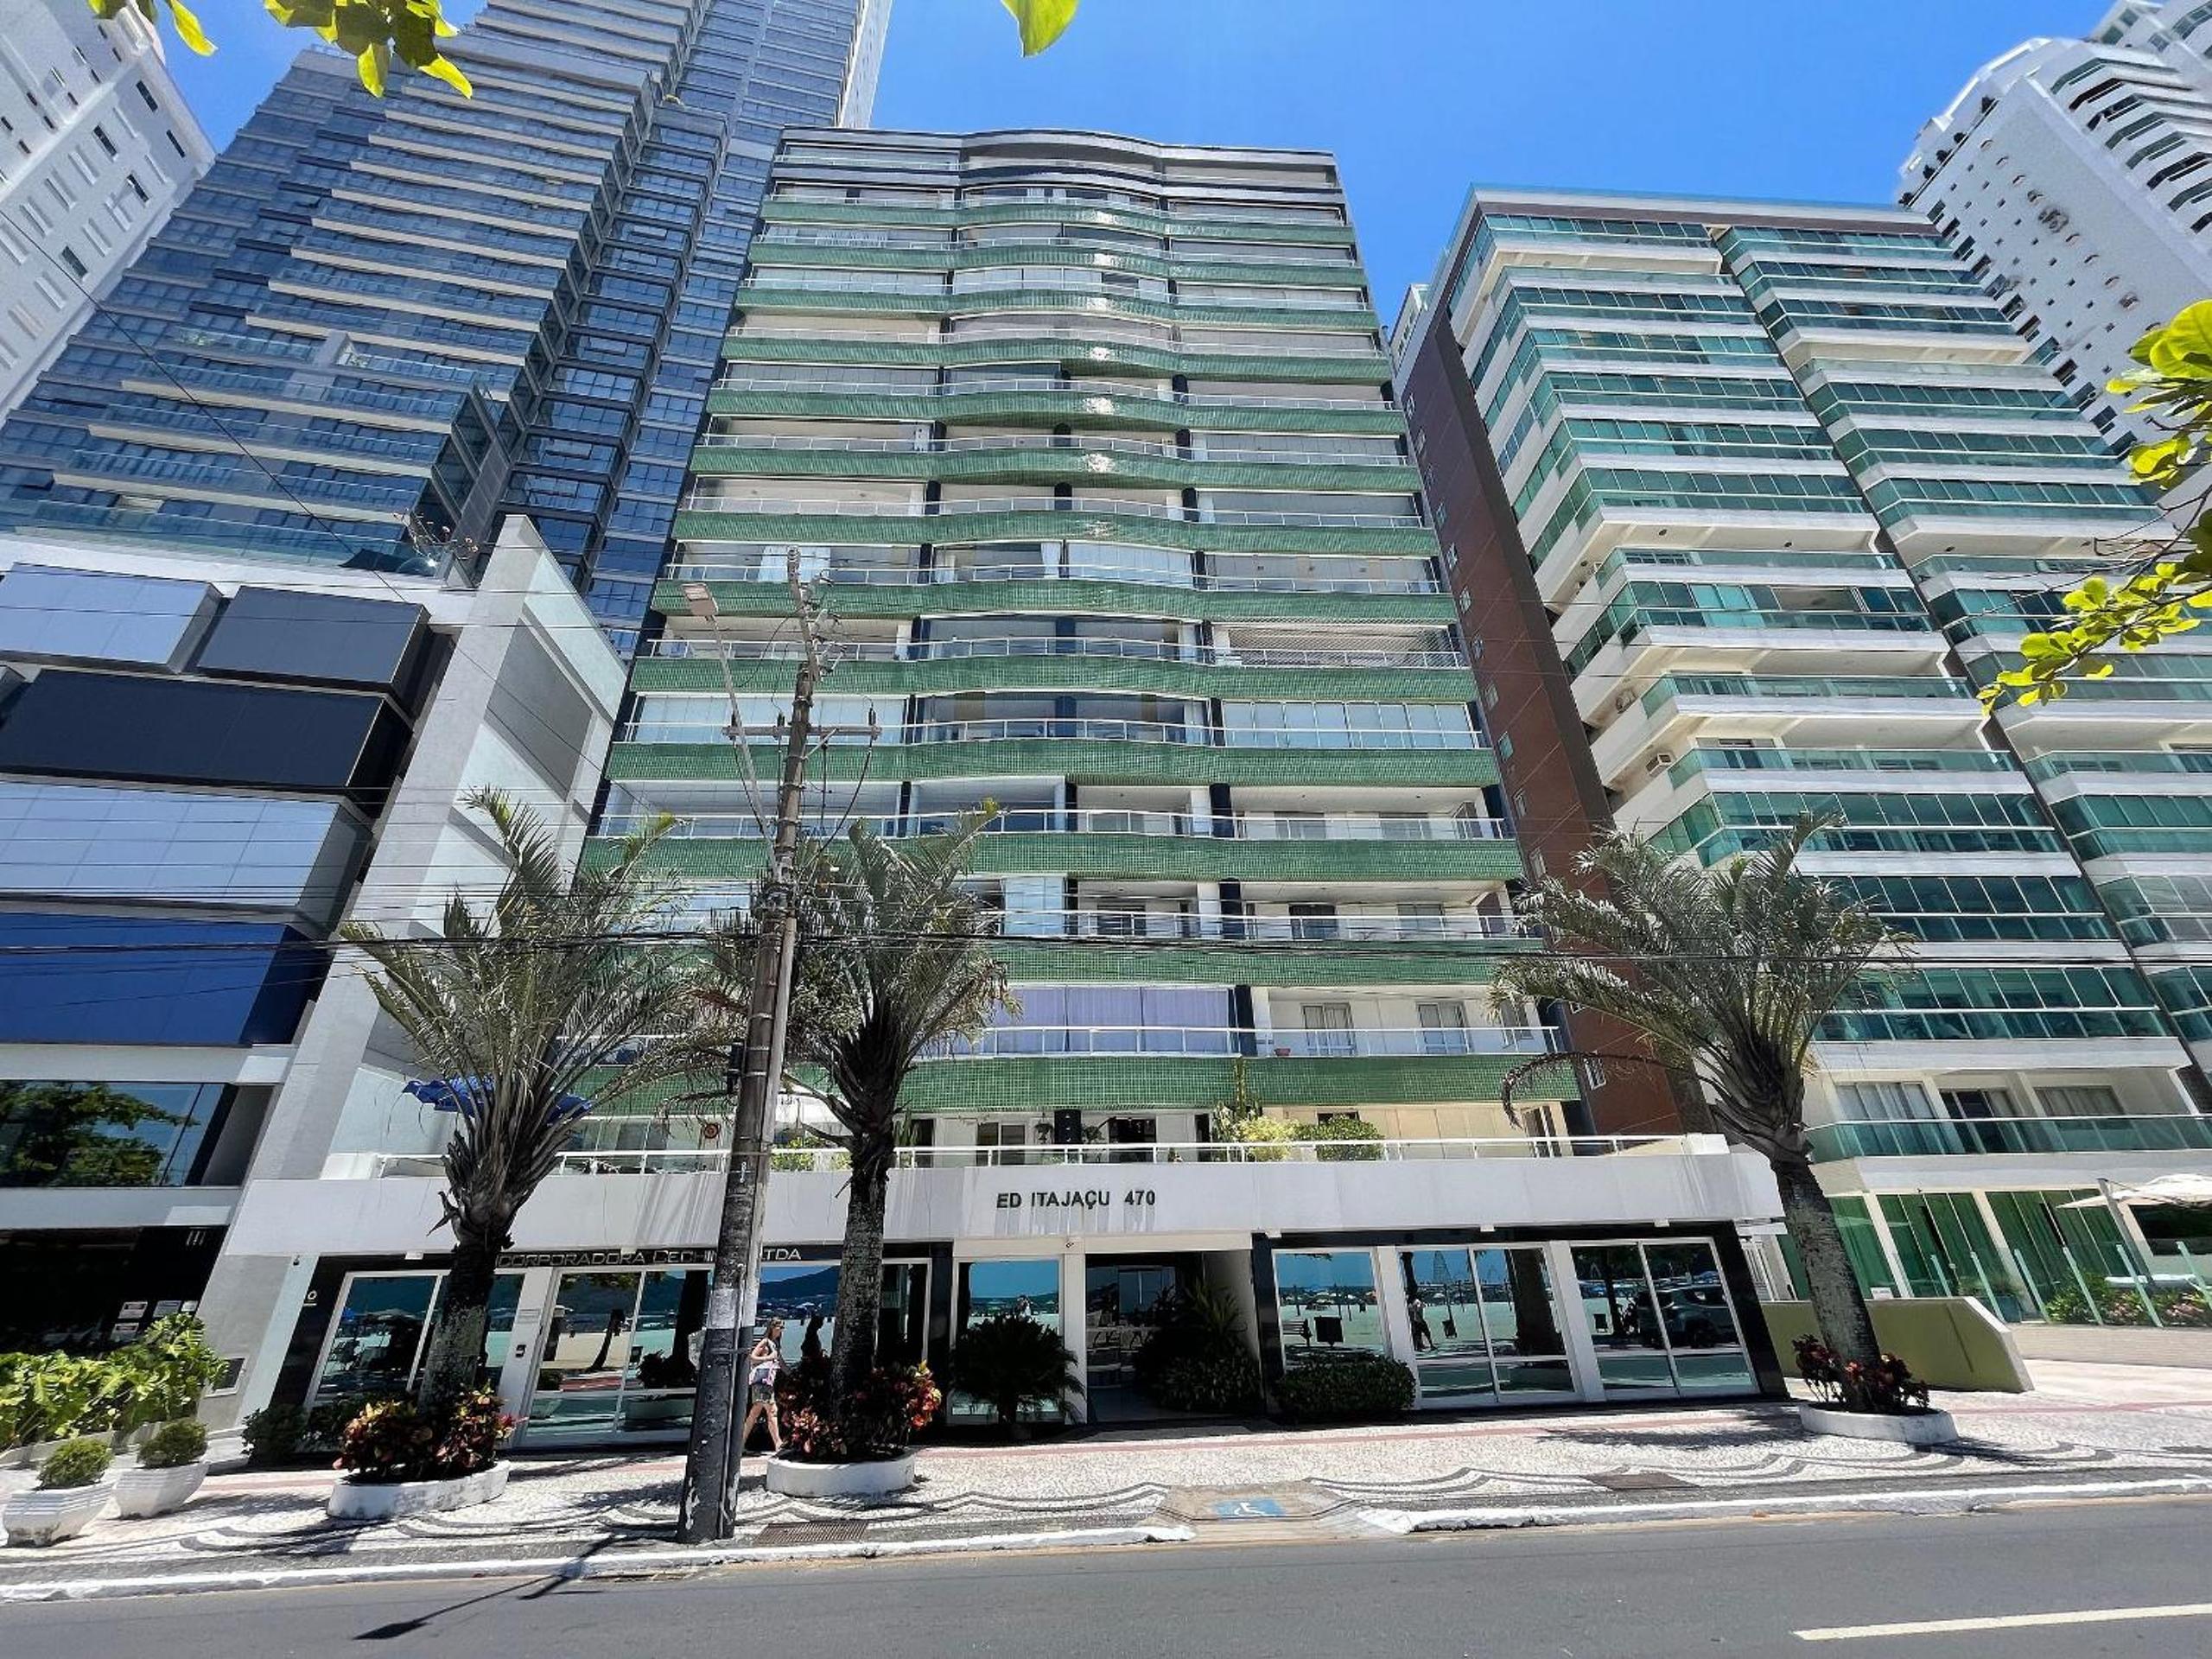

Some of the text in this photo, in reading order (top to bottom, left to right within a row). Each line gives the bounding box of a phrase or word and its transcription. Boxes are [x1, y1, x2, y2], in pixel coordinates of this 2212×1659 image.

[996, 1190, 1156, 1210] ED ITAJAÇU 470
[494, 1251, 646, 1268] CORPORADORA
